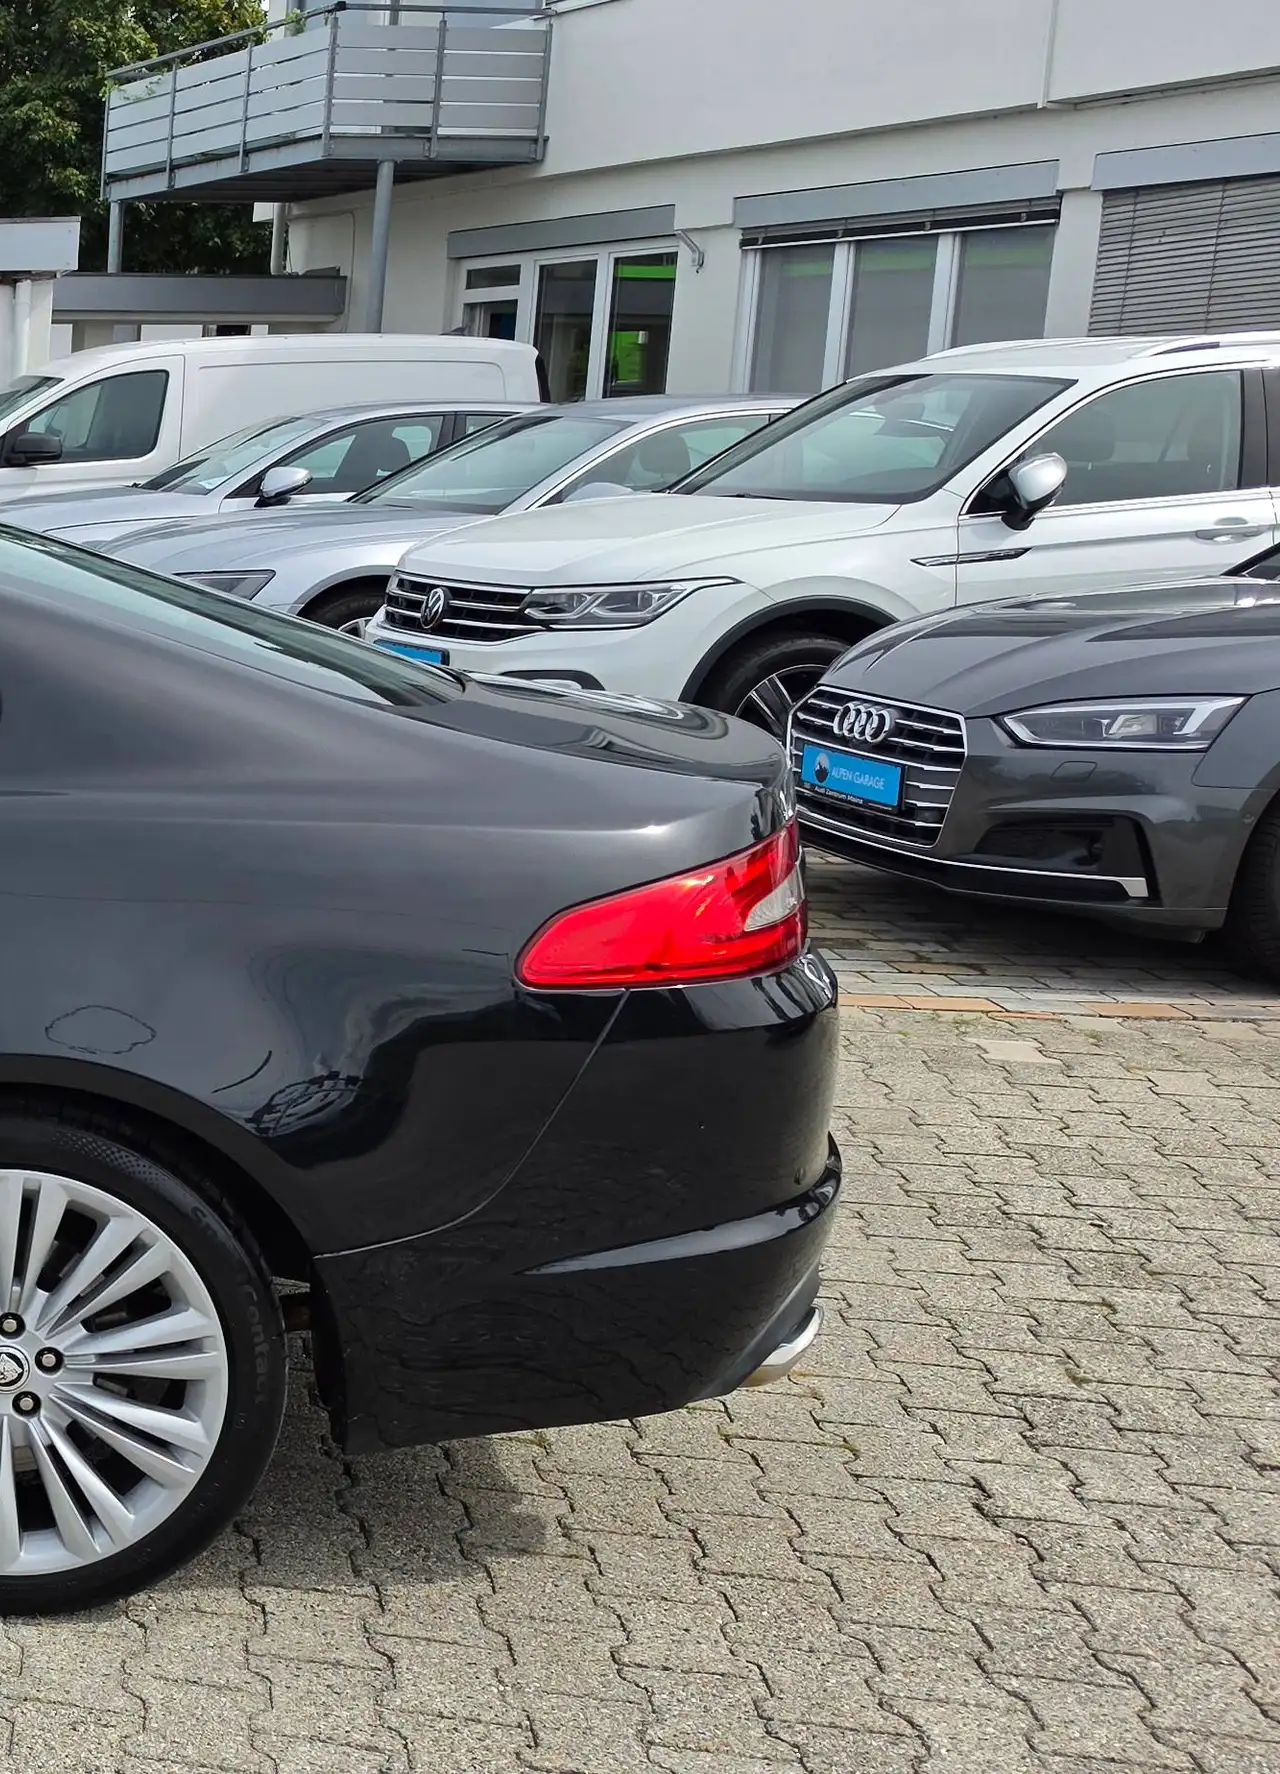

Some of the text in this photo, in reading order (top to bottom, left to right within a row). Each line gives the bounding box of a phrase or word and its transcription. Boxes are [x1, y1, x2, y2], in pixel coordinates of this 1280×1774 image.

[831, 766, 885, 790] ALPEN GARAGE
[814, 785, 826, 793] Audi
